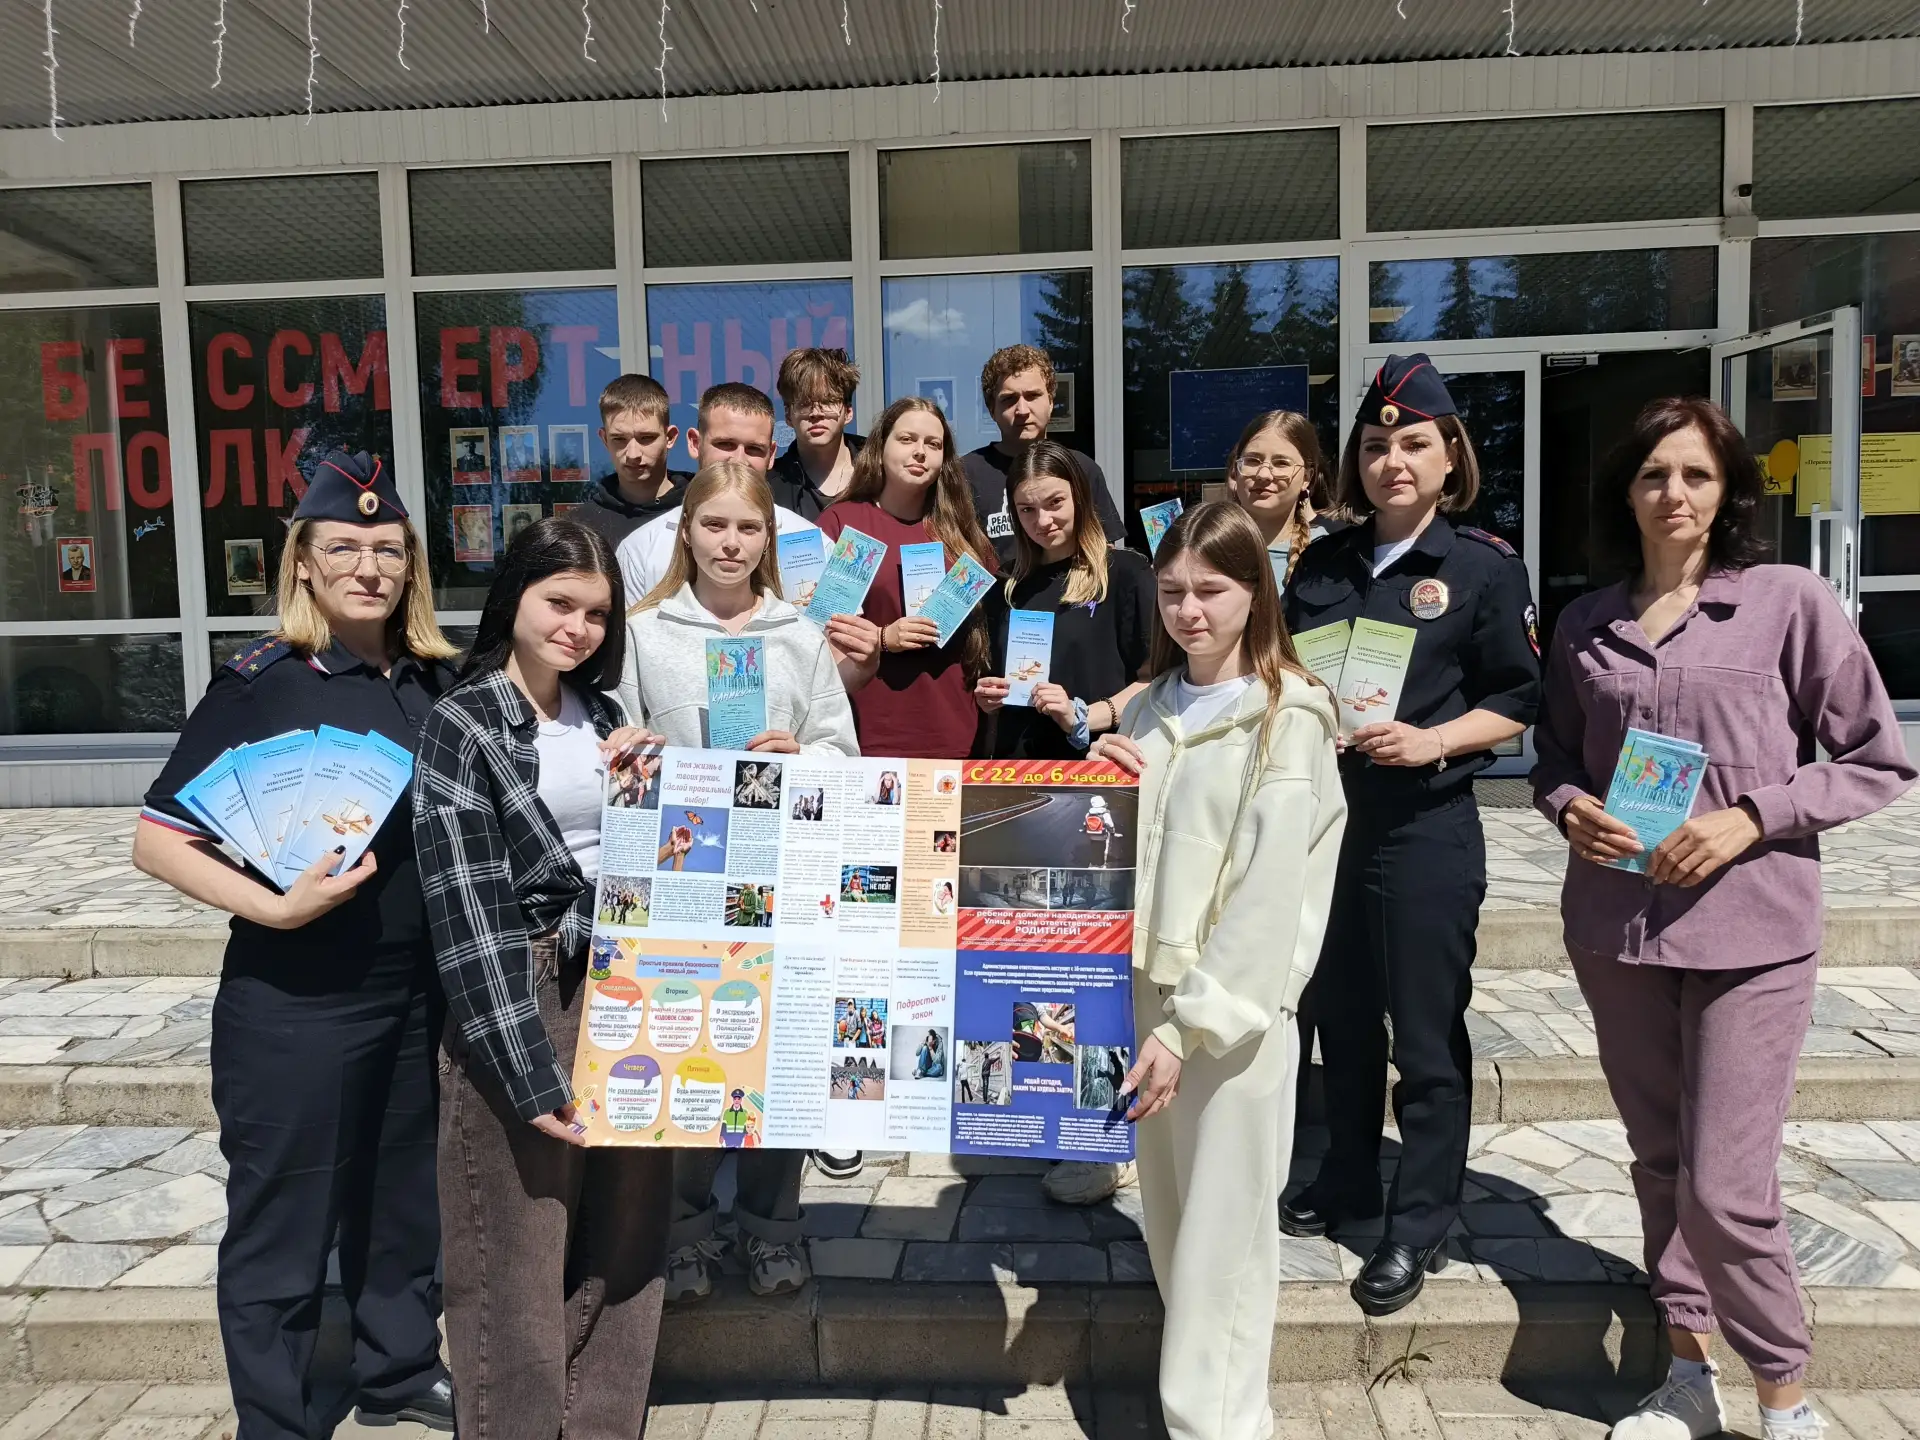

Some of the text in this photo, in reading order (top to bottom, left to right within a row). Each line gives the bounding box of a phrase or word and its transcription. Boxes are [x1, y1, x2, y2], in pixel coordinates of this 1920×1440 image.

[71, 428, 312, 513] ПОЛК
[991, 524, 1010, 535] HOOL
[970, 767, 1132, 783] С 22 до 6 часов...
[663, 782, 732, 794] Сделай правильный
[684, 796, 710, 805] выбор!
[1620, 800, 1682, 815] КАНИКУЛЫ
[977, 910, 1013, 918] ребенок
[1015, 911, 1049, 919] должен
[1051, 912, 1101, 920] находиться
[1103, 912, 1128, 920] дома!
[984, 917, 1011, 926] Улица
[1040, 919, 1112, 928] ответственности
[1015, 926, 1081, 935] РОДИТЕЛЕЙ!
[665, 987, 689, 996] Вторник
[896, 994, 946, 1010] Подросток и
[911, 1010, 933, 1020] закон
[716, 1024, 754, 1032] Полицейский
[623, 1063, 646, 1072] Четверг
[623, 1113, 653, 1121] открывай
